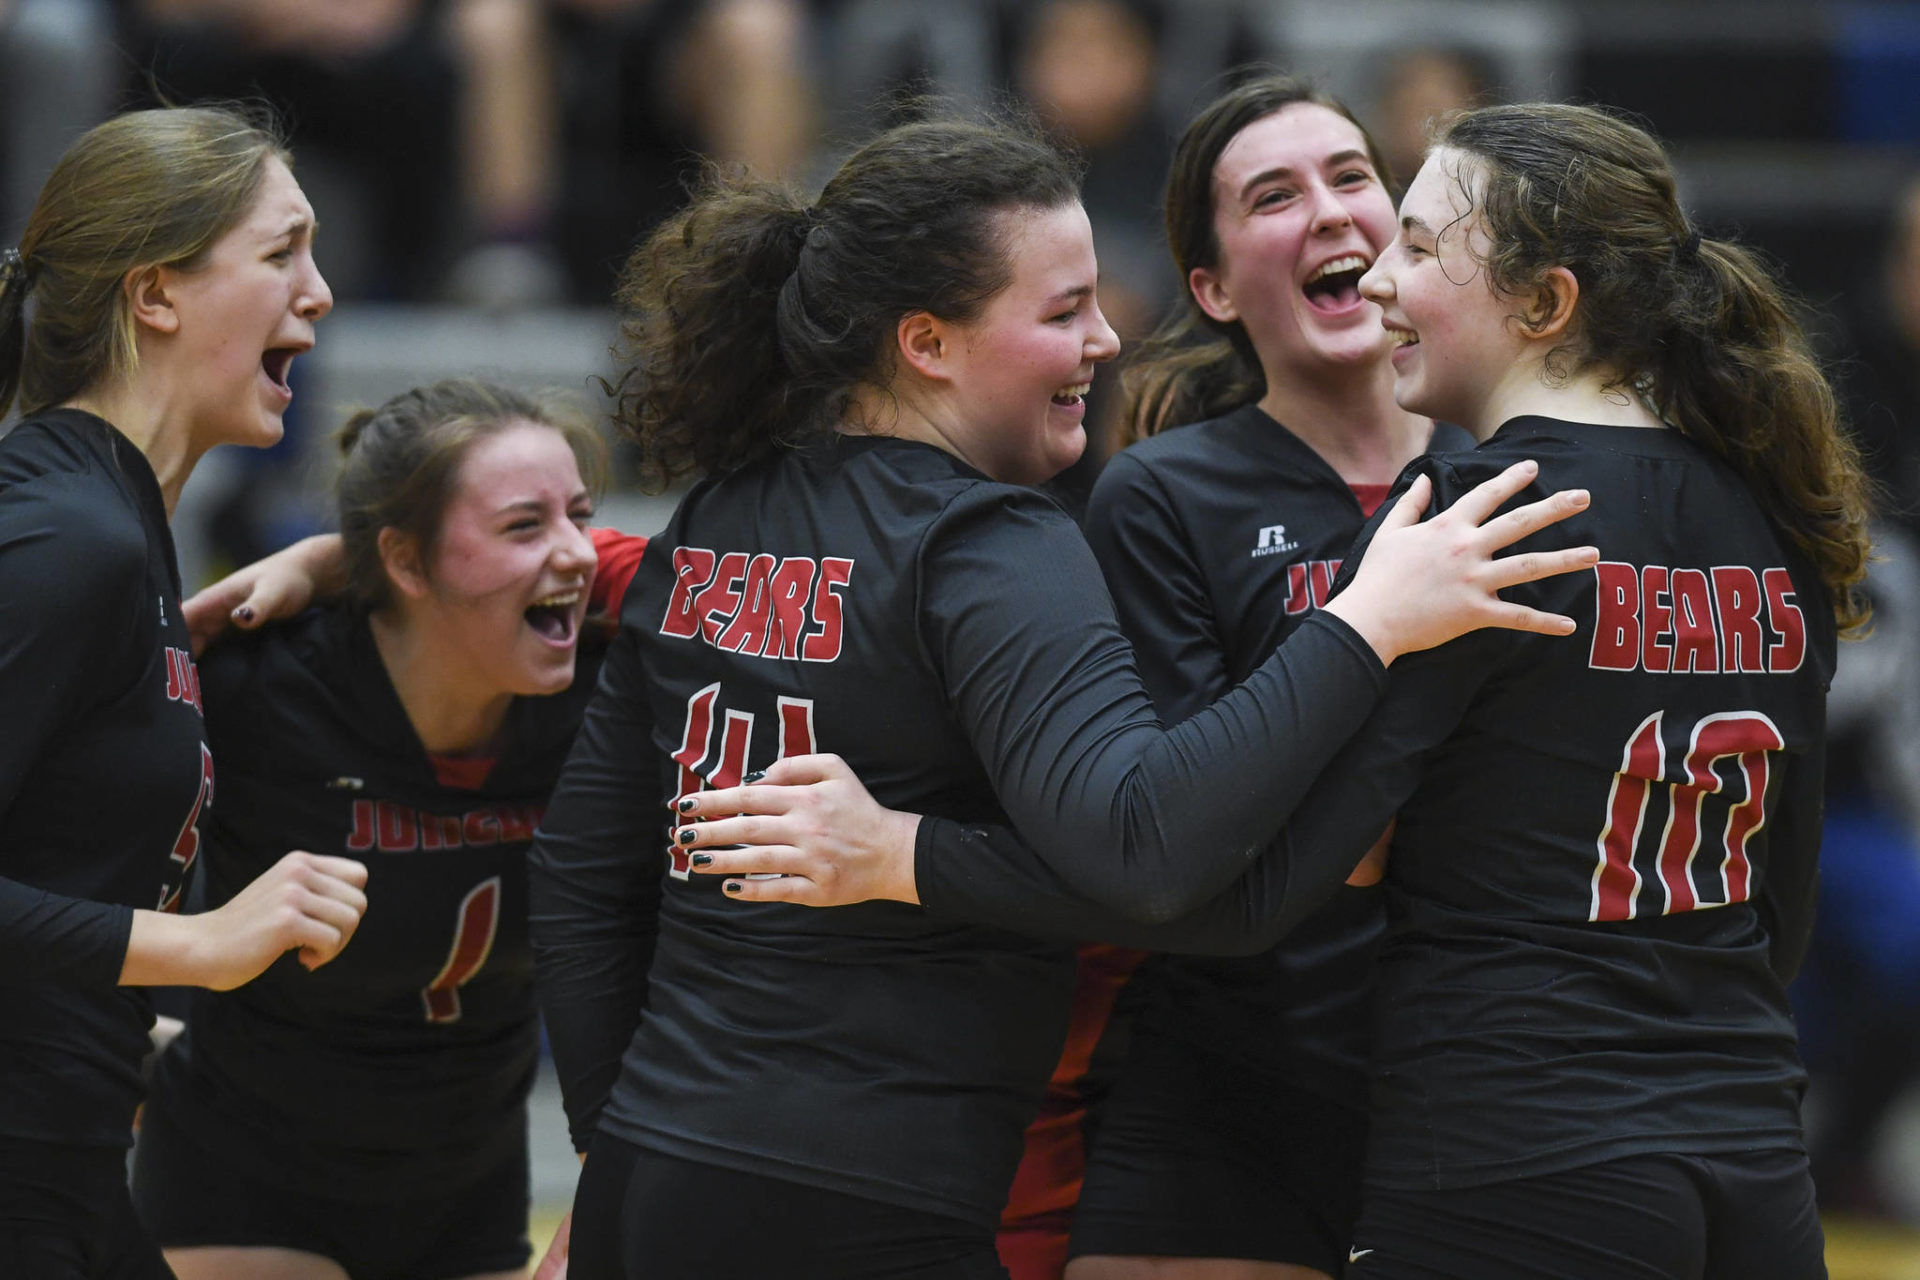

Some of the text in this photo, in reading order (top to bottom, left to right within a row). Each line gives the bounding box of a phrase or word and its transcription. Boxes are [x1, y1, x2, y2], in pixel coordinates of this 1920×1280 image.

[659, 546, 855, 663] BEARS
[1588, 561, 1806, 674] BEARS
[1588, 710, 1785, 922] 10
[422, 876, 500, 1023] 1
